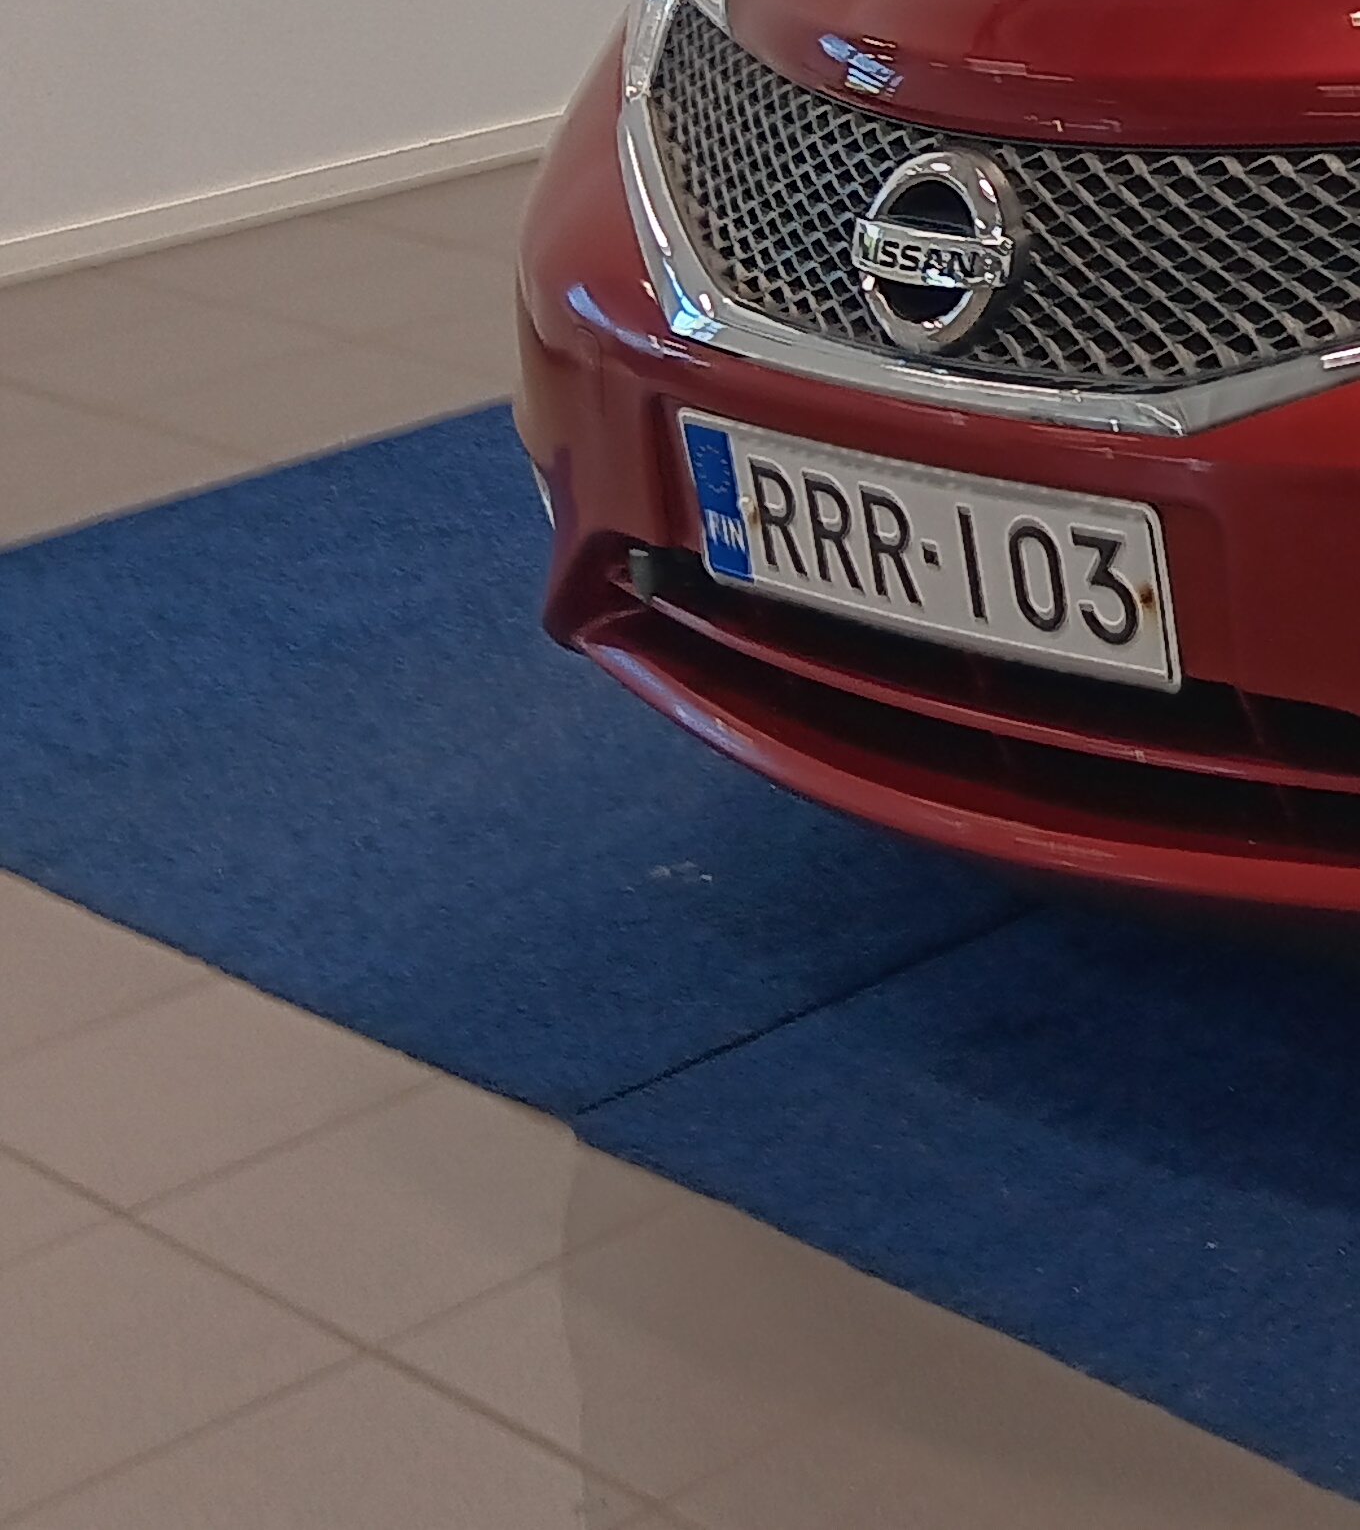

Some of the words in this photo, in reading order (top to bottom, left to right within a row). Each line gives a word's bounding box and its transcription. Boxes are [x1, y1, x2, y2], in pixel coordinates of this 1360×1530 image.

[856, 229, 980, 279] NISSAN
[705, 508, 746, 553] FIN
[747, 455, 1142, 644] RRR-103
